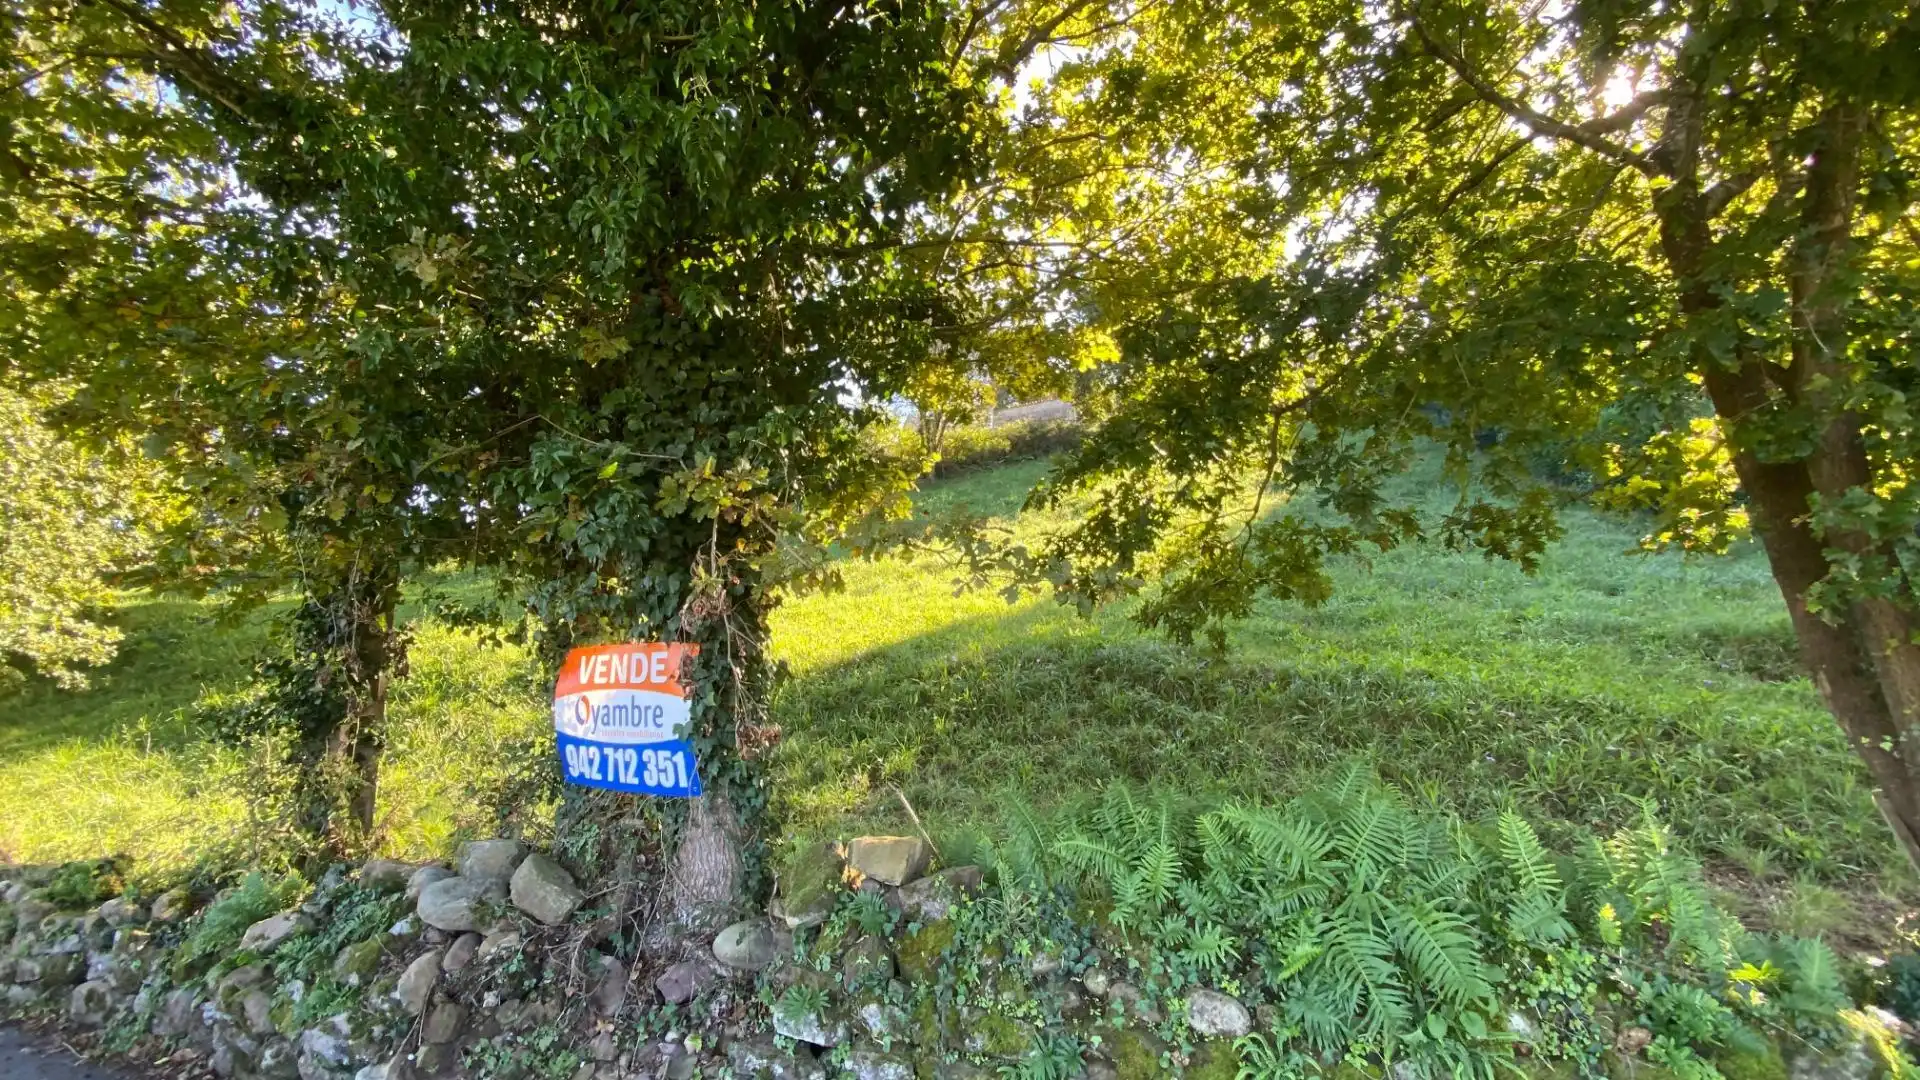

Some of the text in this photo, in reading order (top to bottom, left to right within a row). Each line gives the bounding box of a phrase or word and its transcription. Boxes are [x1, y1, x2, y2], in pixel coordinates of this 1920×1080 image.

[579, 652, 668, 684] VENDE
[575, 695, 664, 734] Oyambre
[565, 744, 688, 788] 942 712 351
